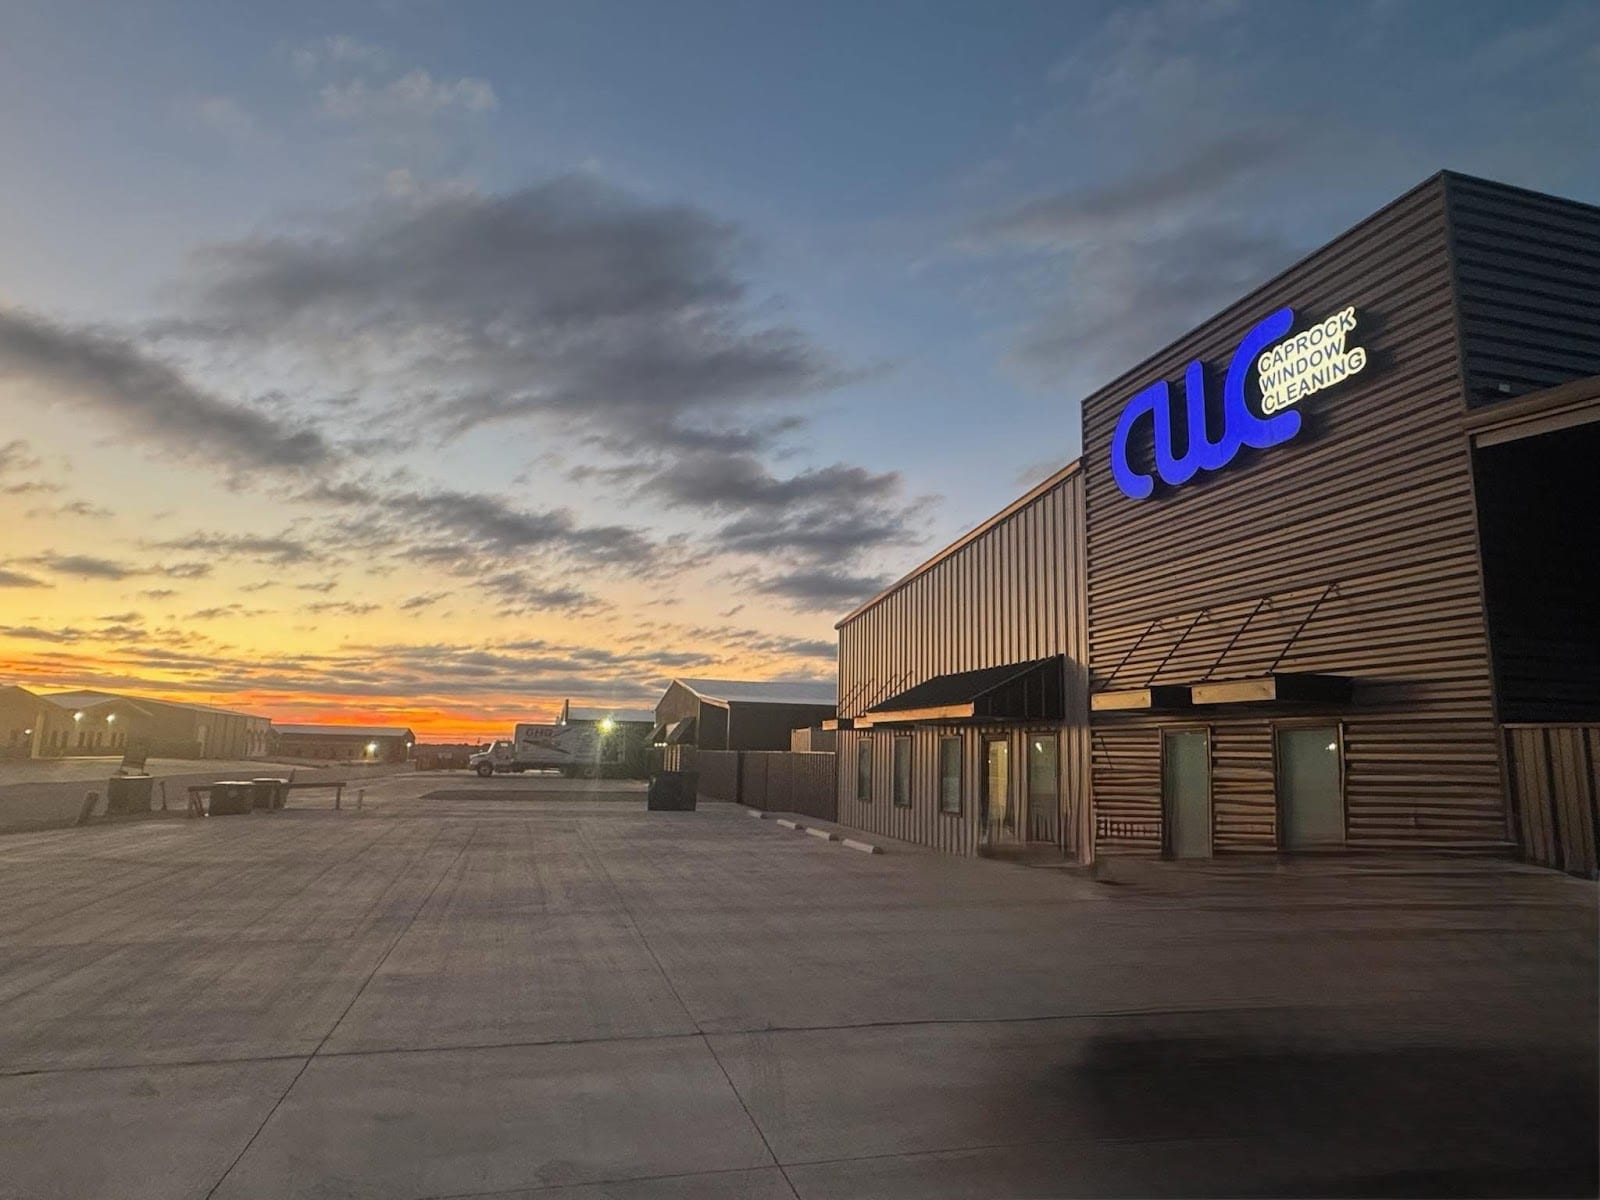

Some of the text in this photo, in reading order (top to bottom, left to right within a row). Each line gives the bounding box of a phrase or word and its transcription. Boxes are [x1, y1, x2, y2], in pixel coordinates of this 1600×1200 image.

[1259, 310, 1354, 373] CAPROCK
[1261, 337, 1342, 393] WINDOW
[1263, 351, 1363, 412] CLEANING
